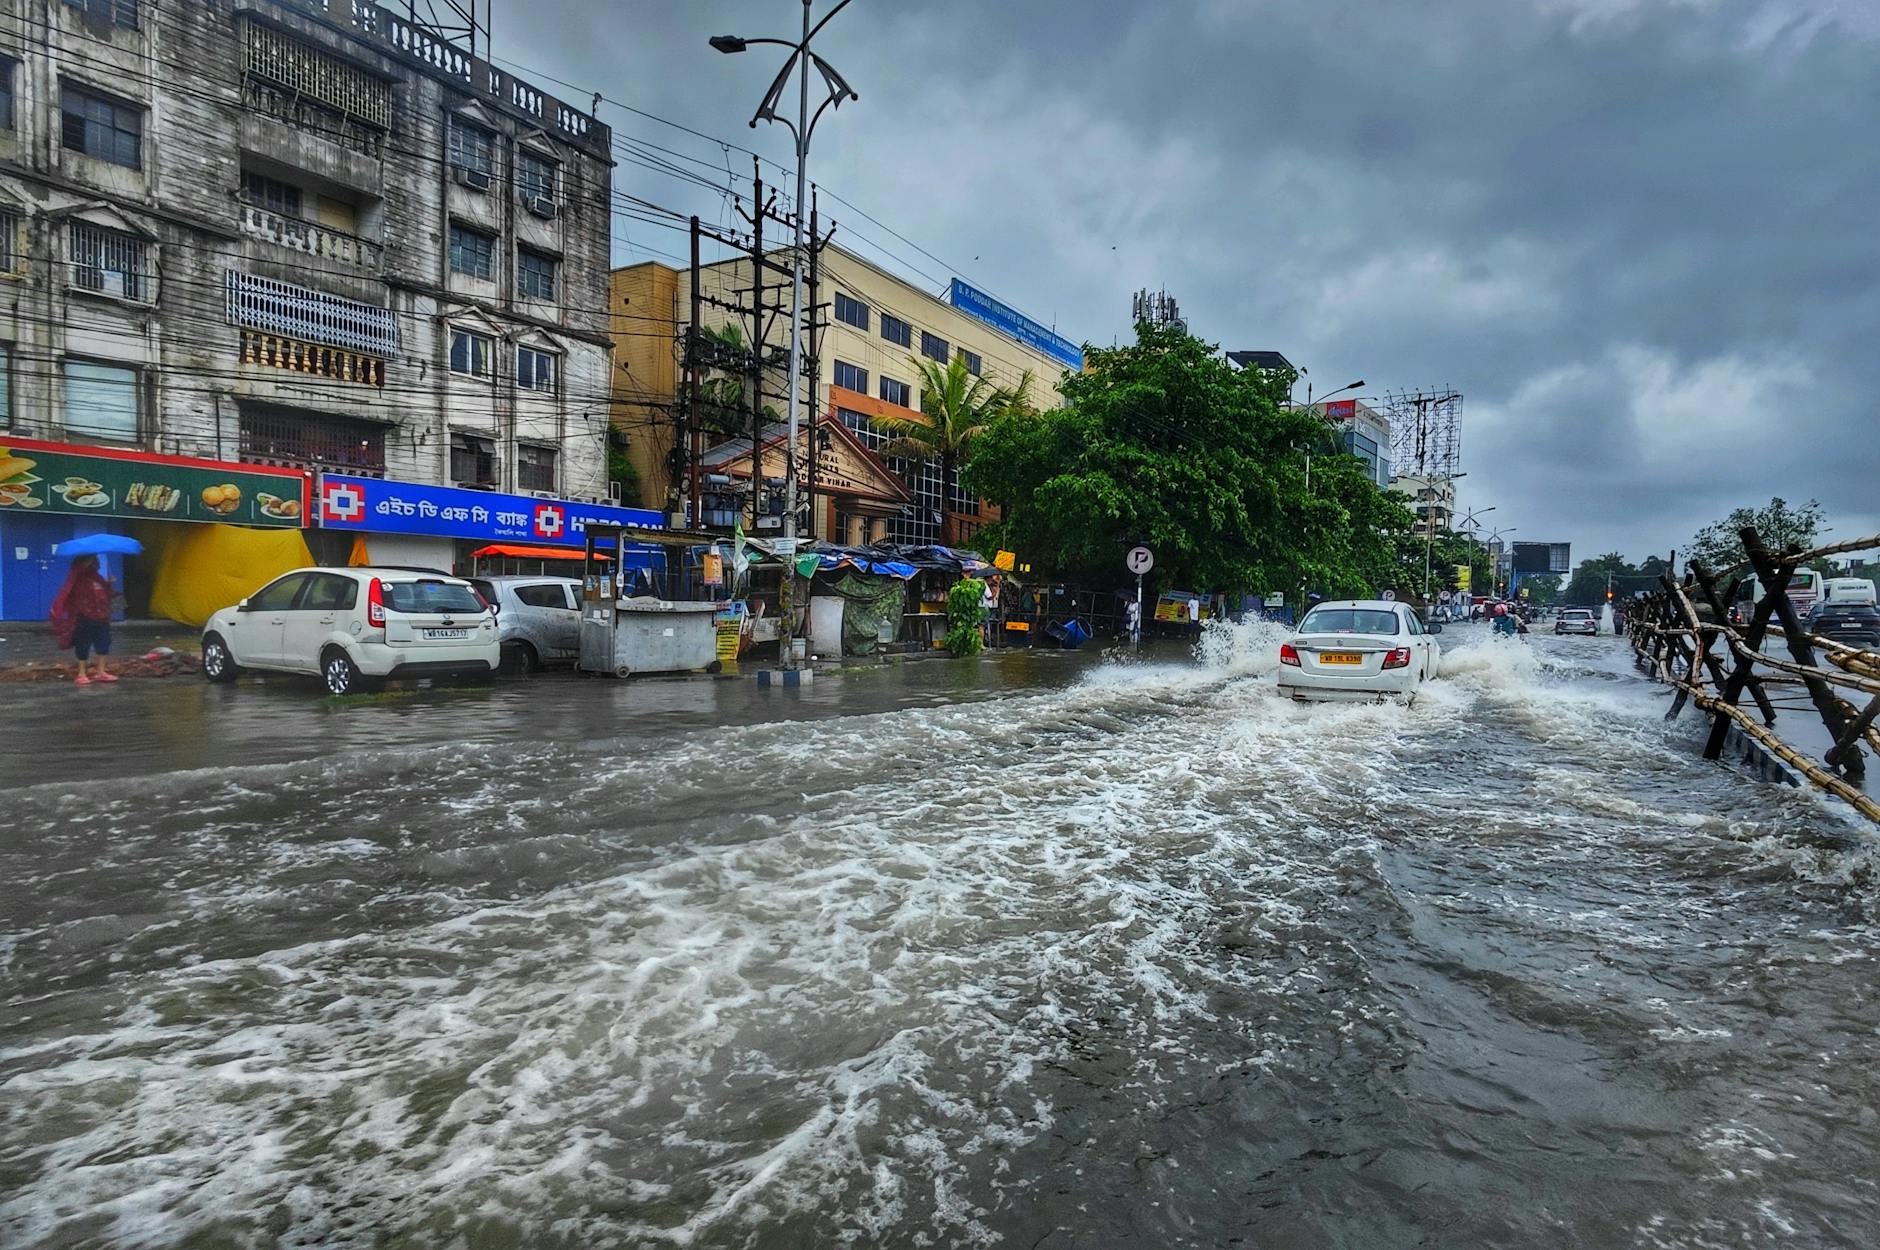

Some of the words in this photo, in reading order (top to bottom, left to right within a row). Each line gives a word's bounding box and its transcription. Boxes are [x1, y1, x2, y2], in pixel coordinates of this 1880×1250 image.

[991, 301, 1016, 324] INSTITUTE
[1016, 317, 1023, 327] OF
[1023, 321, 1051, 342] MANAGEMENT
[1056, 338, 1079, 357] TECHNOLOGY
[827, 477, 851, 488] VIHAR
[375, 496, 416, 516] এইচ
[417, 500, 438, 518] ডি
[440, 506, 469, 522] এফ
[471, 505, 489, 524] সি
[1134, 551, 1149, 569] P
